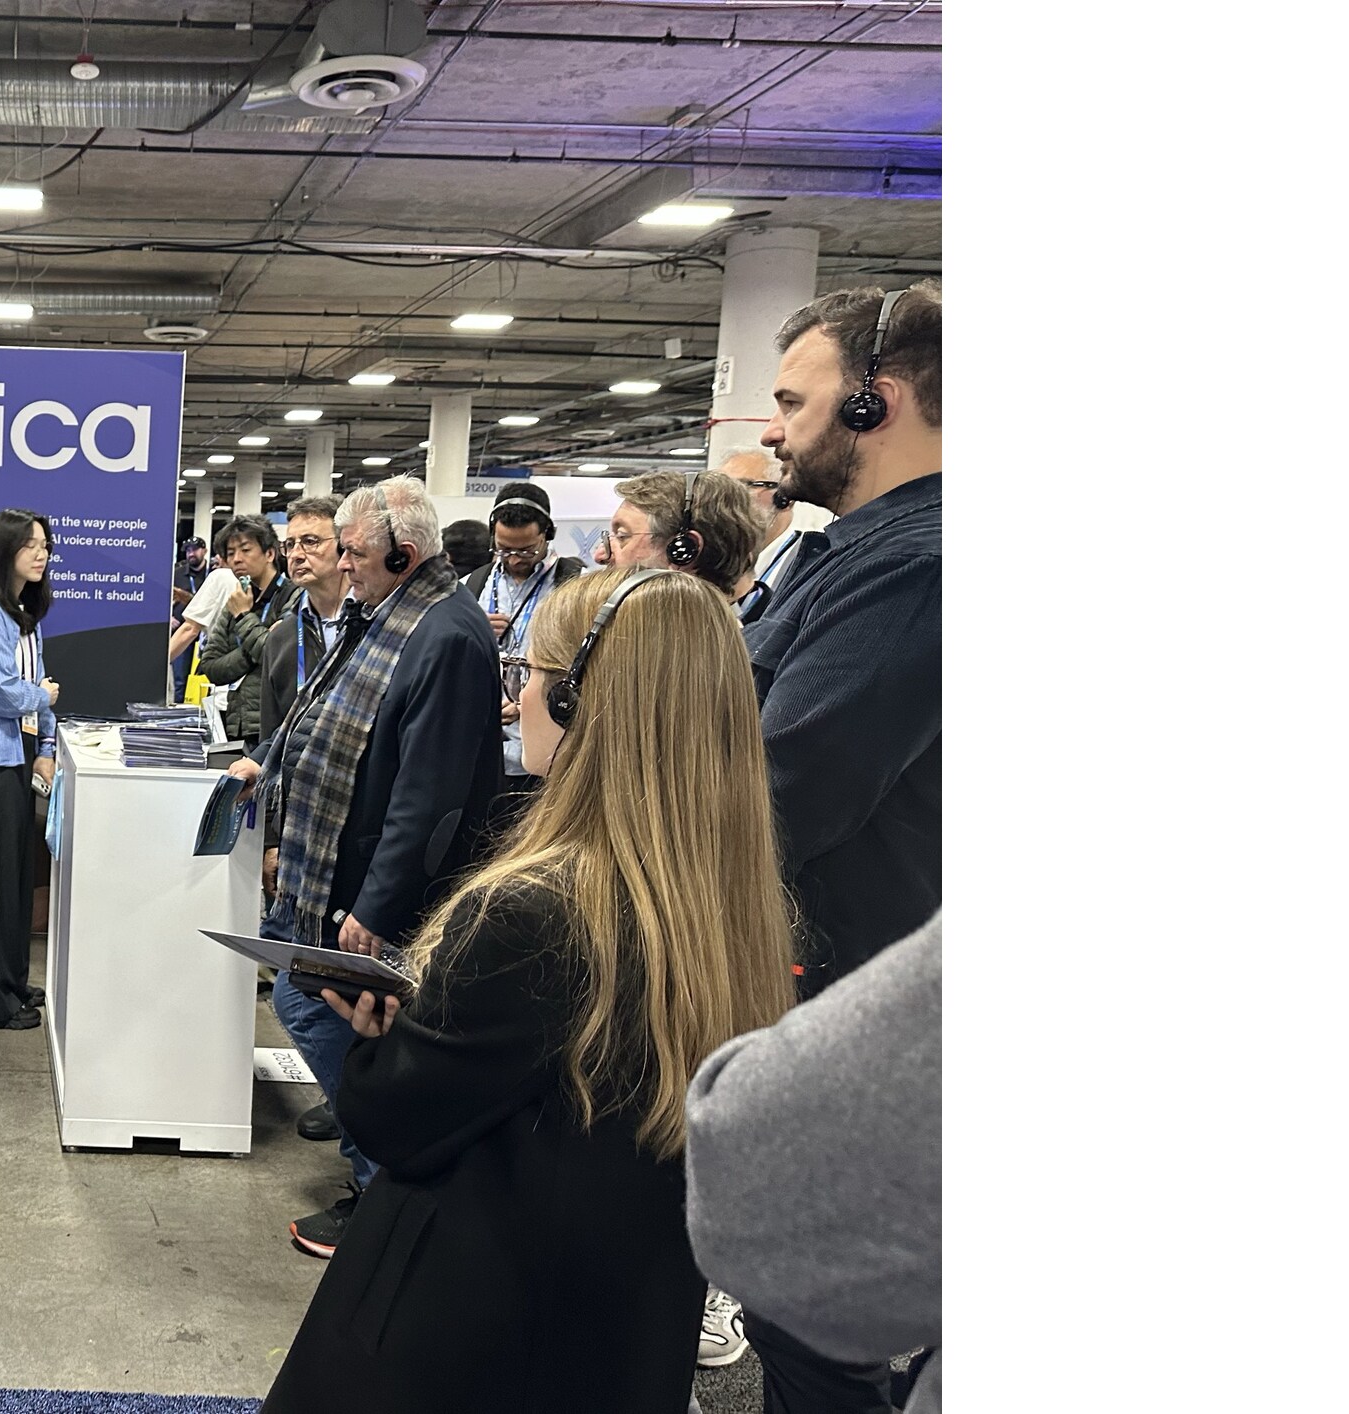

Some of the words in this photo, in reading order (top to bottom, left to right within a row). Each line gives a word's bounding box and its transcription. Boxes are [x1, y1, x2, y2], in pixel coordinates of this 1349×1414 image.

[49, 515, 59, 526] in
[62, 516, 80, 527] the
[83, 520, 106, 530] way
[109, 519, 147, 531] people
[63, 535, 93, 545] voice
[95, 537, 146, 549] recorder,
[49, 570, 76, 581] feels
[80, 572, 120, 582] natural
[123, 573, 144, 583] and
[52, 588, 91, 600] ention.
[95, 589, 102, 599] It
[107, 590, 144, 601] should
